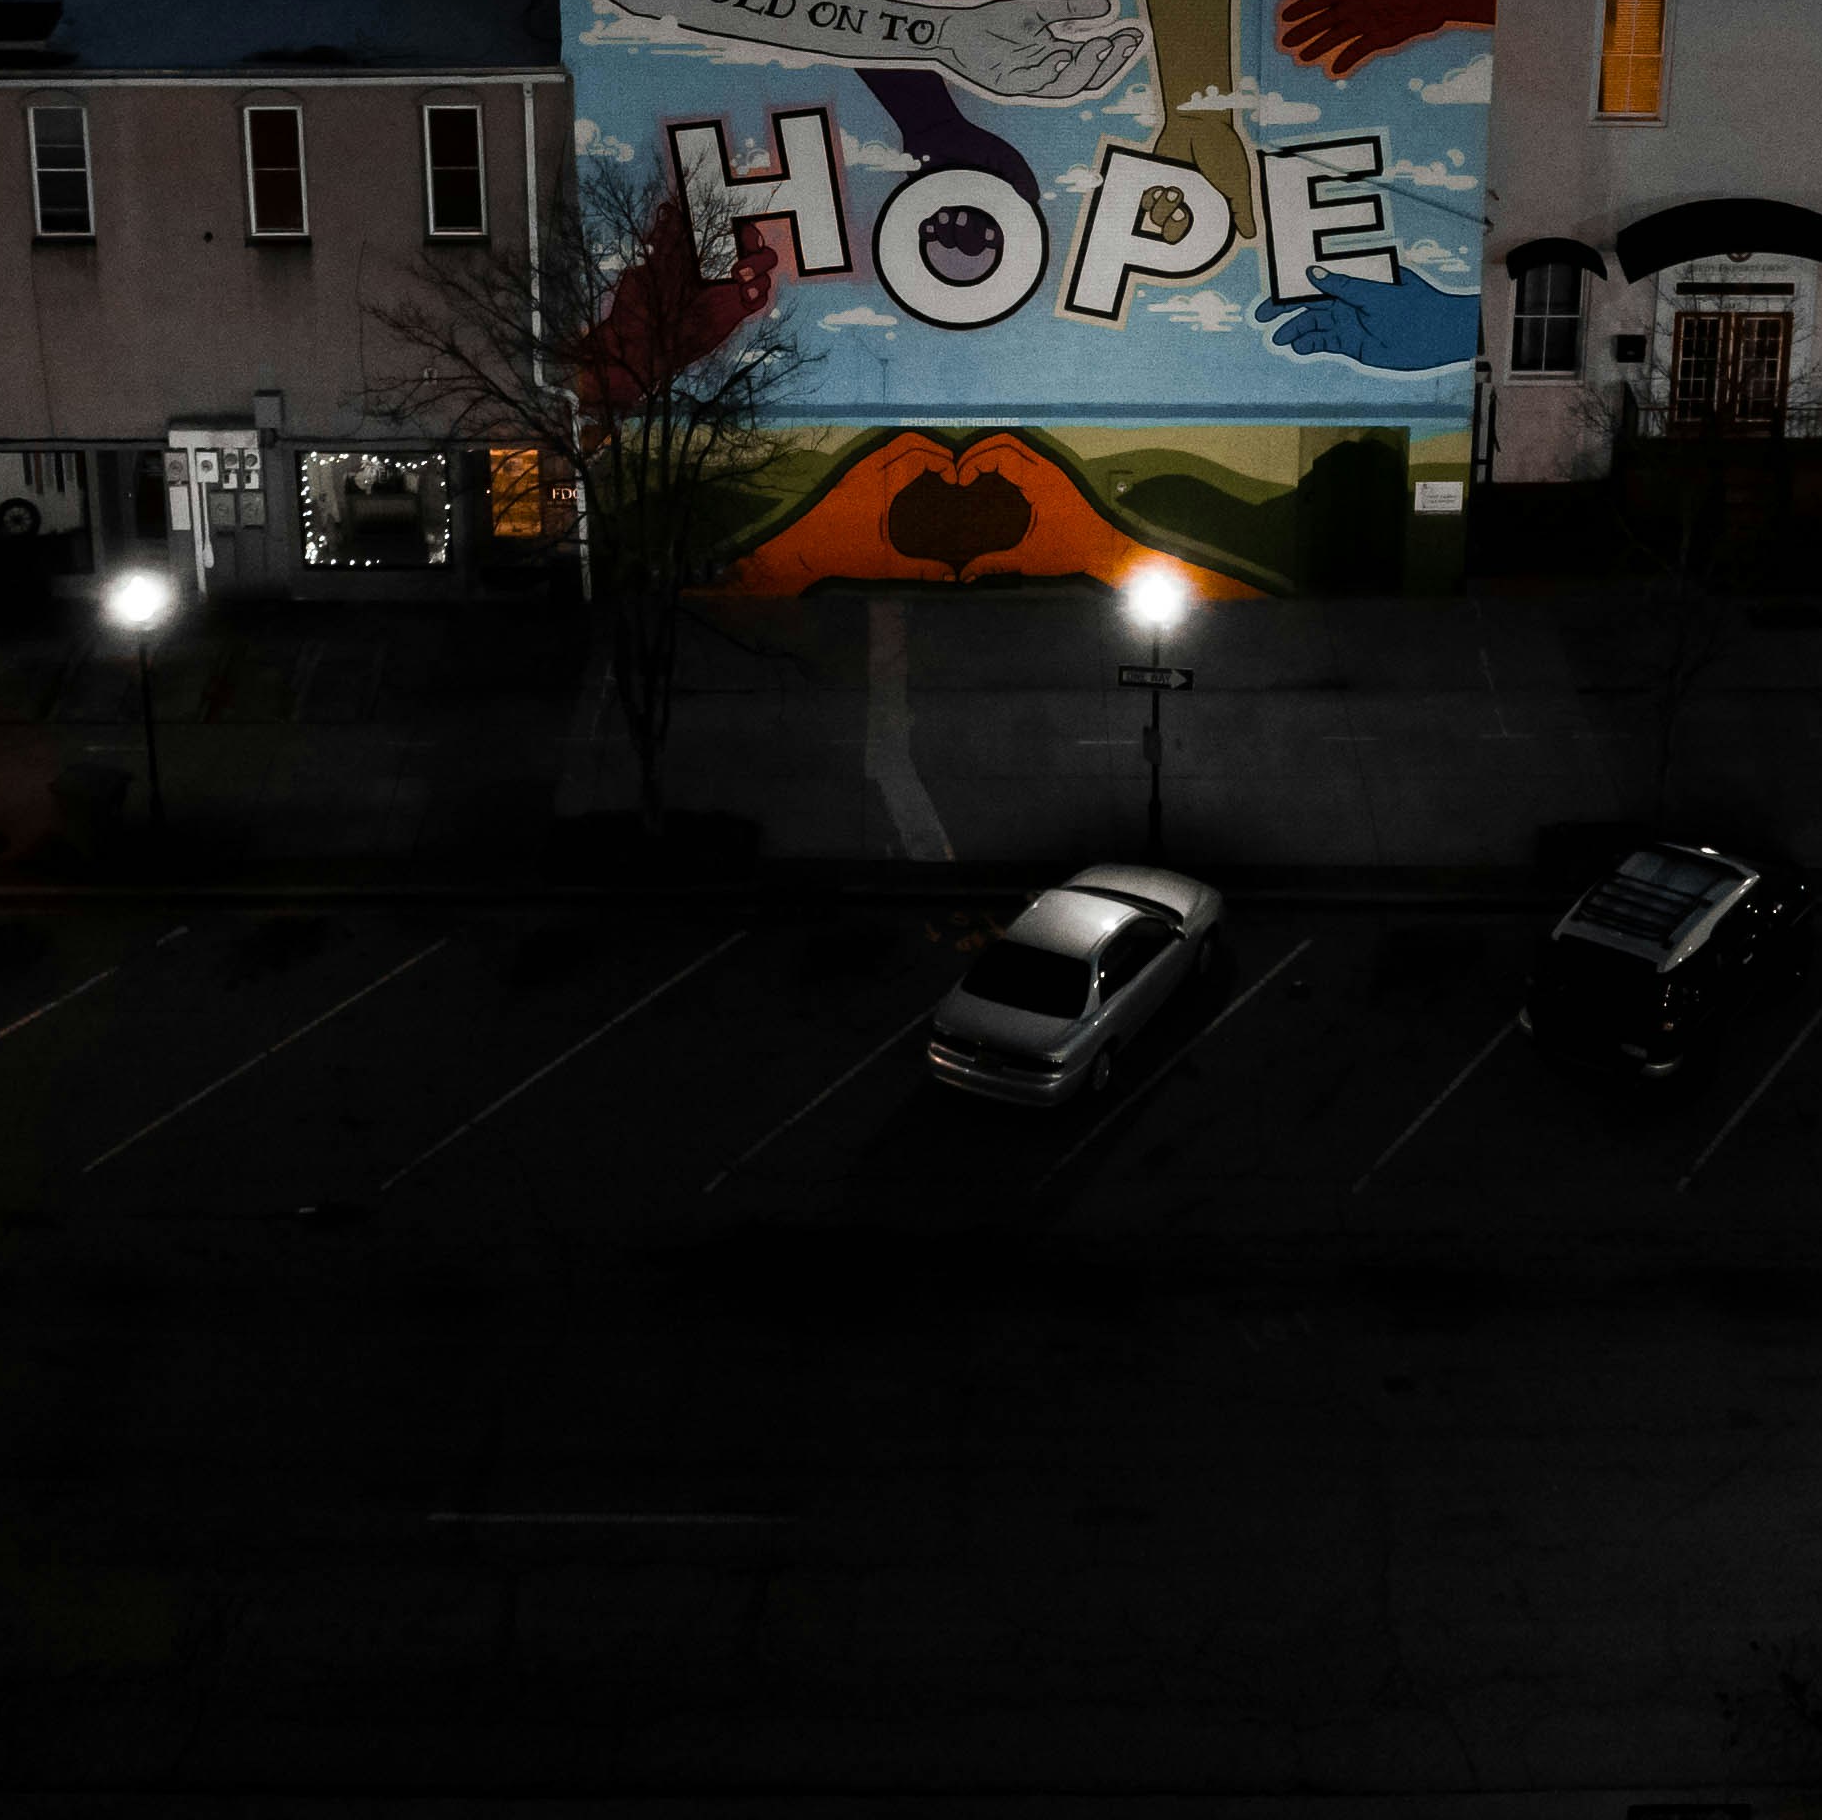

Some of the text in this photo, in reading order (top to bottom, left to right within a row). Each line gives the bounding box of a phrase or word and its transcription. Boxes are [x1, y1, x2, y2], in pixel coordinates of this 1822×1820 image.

[808, 0, 869, 32] ON
[880, 9, 939, 48] TO
[665, 106, 1403, 331] HOPE
